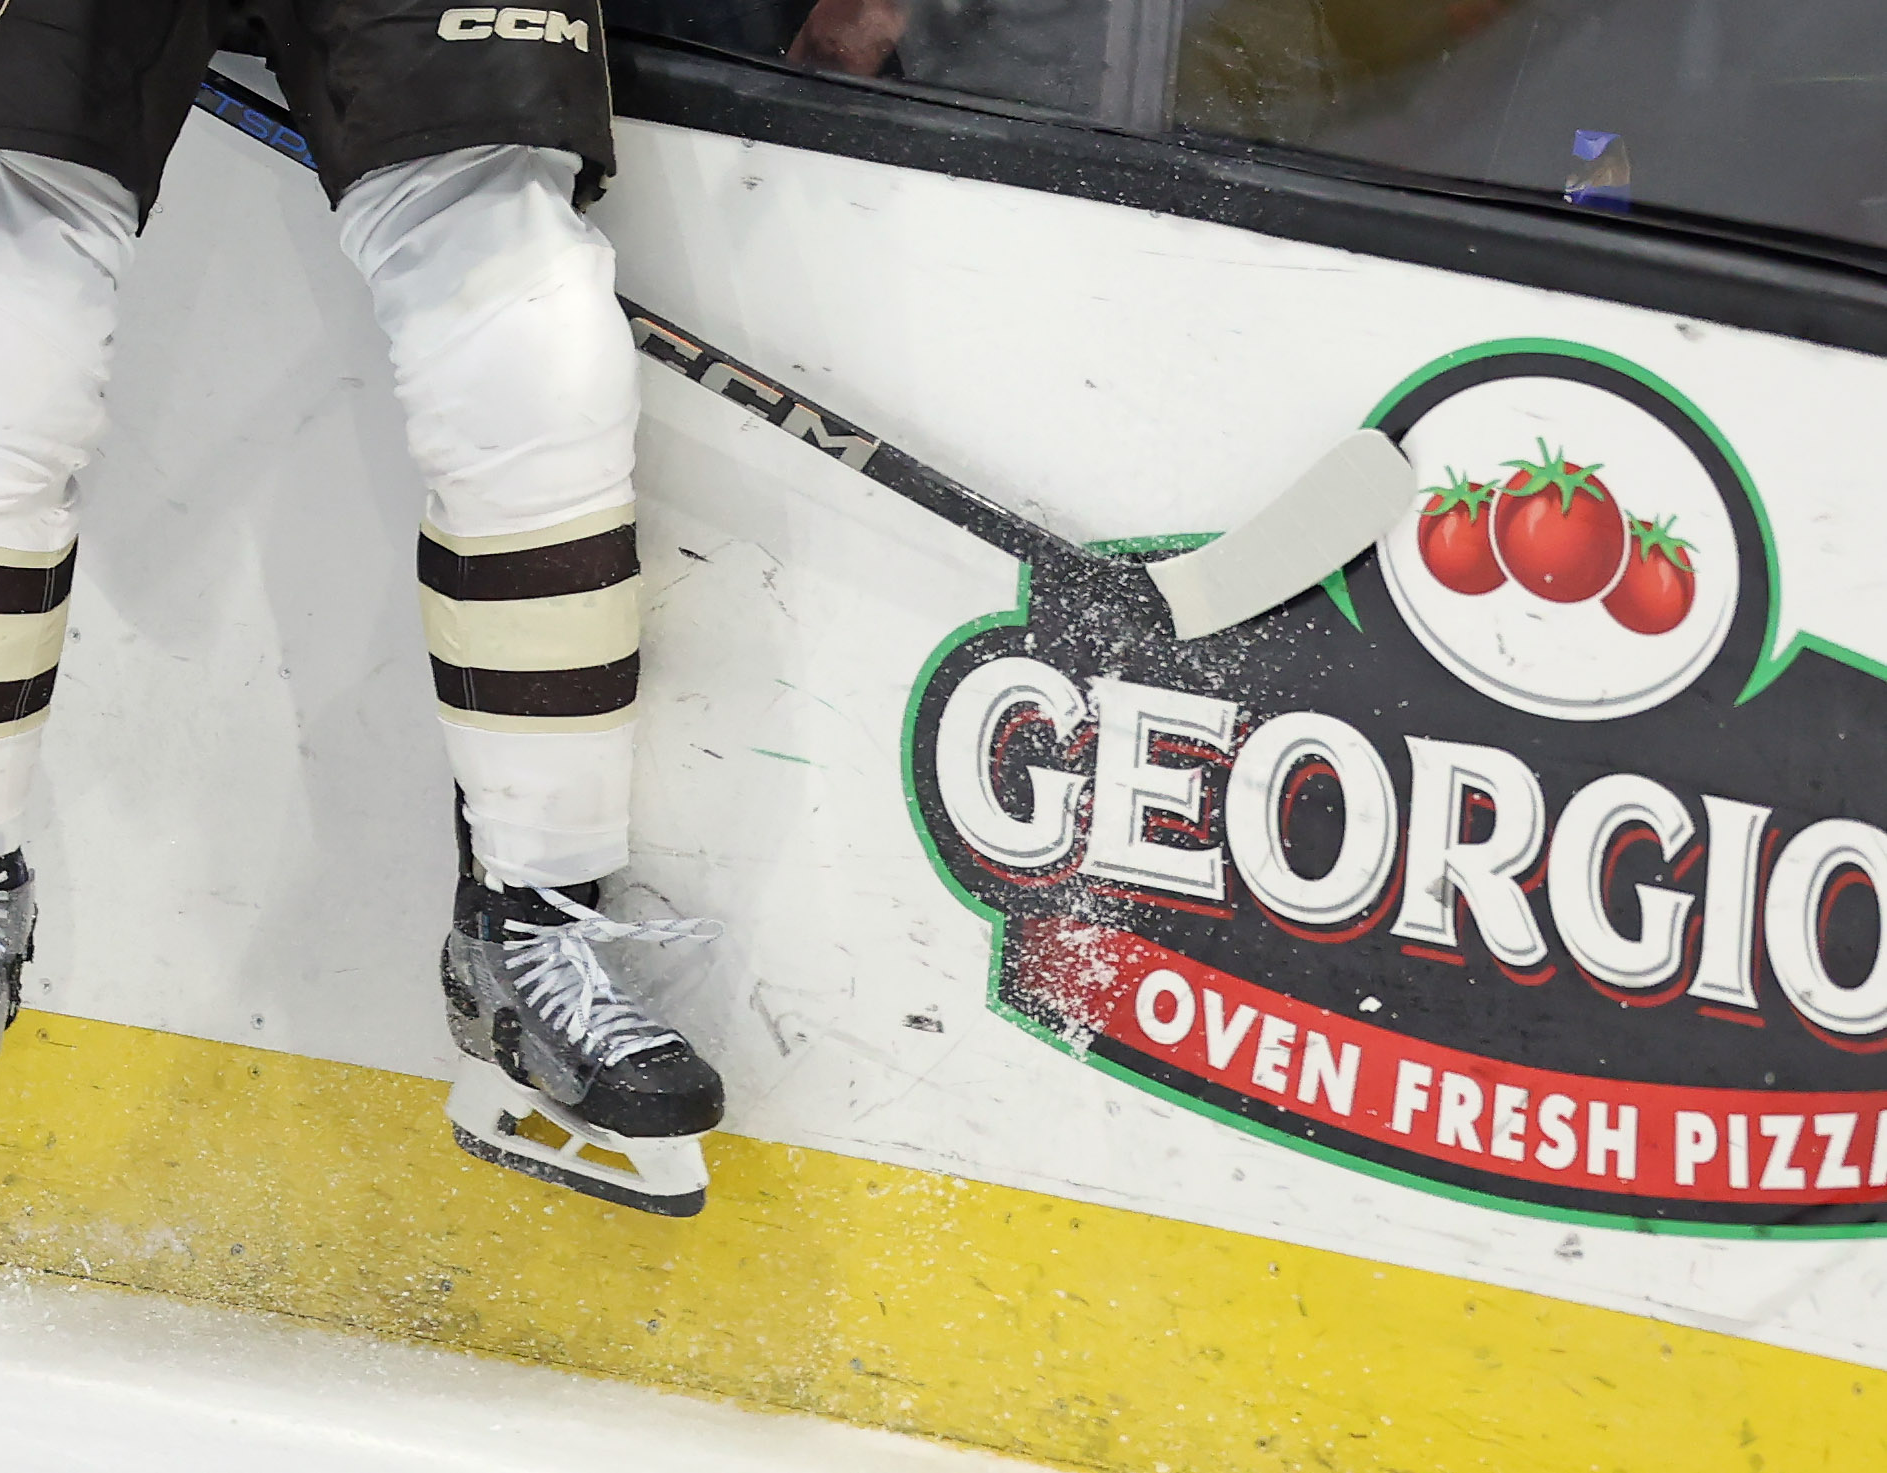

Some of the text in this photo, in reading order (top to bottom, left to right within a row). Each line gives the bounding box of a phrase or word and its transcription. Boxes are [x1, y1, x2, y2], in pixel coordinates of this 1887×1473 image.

[437, 7, 589, 53] CCM
[629, 317, 879, 472] CCM
[1135, 967, 1362, 1119] OVEN
[1392, 1058, 1638, 1180] FRESH
